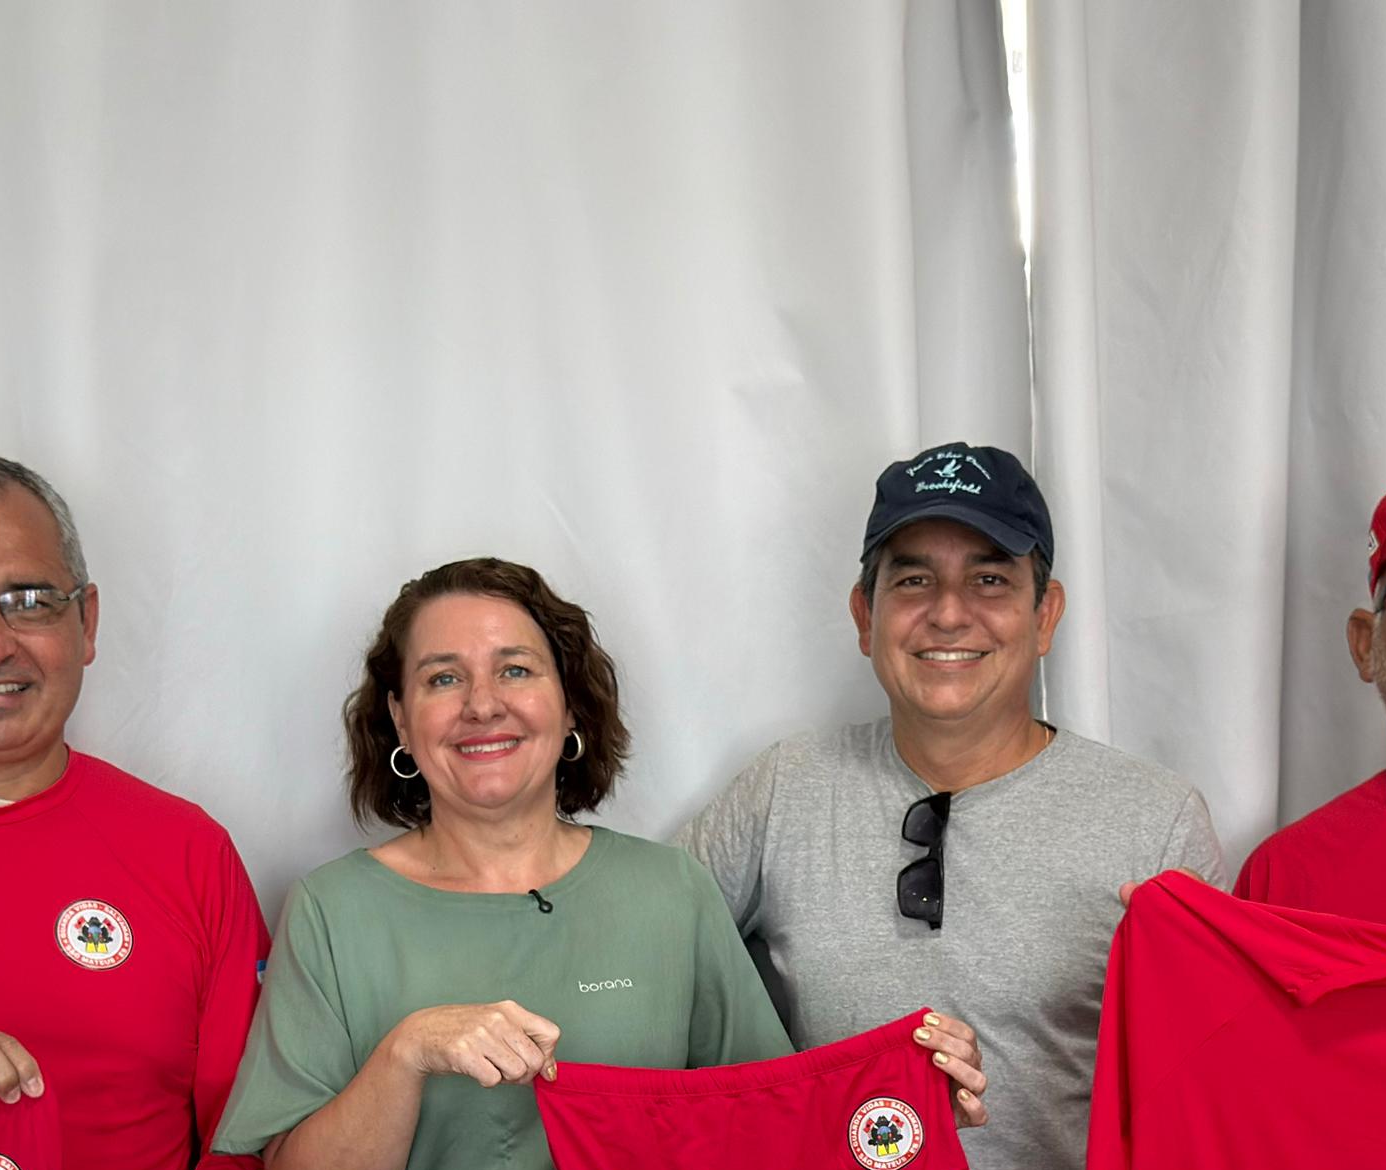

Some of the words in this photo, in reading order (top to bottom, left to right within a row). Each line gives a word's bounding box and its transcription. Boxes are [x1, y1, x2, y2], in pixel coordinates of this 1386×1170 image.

[578, 979, 633, 993] borana
[852, 1114, 863, 1146] GUARDA
[861, 1101, 885, 1113] VIDAS
[873, 1157, 908, 1169] MATEUS
